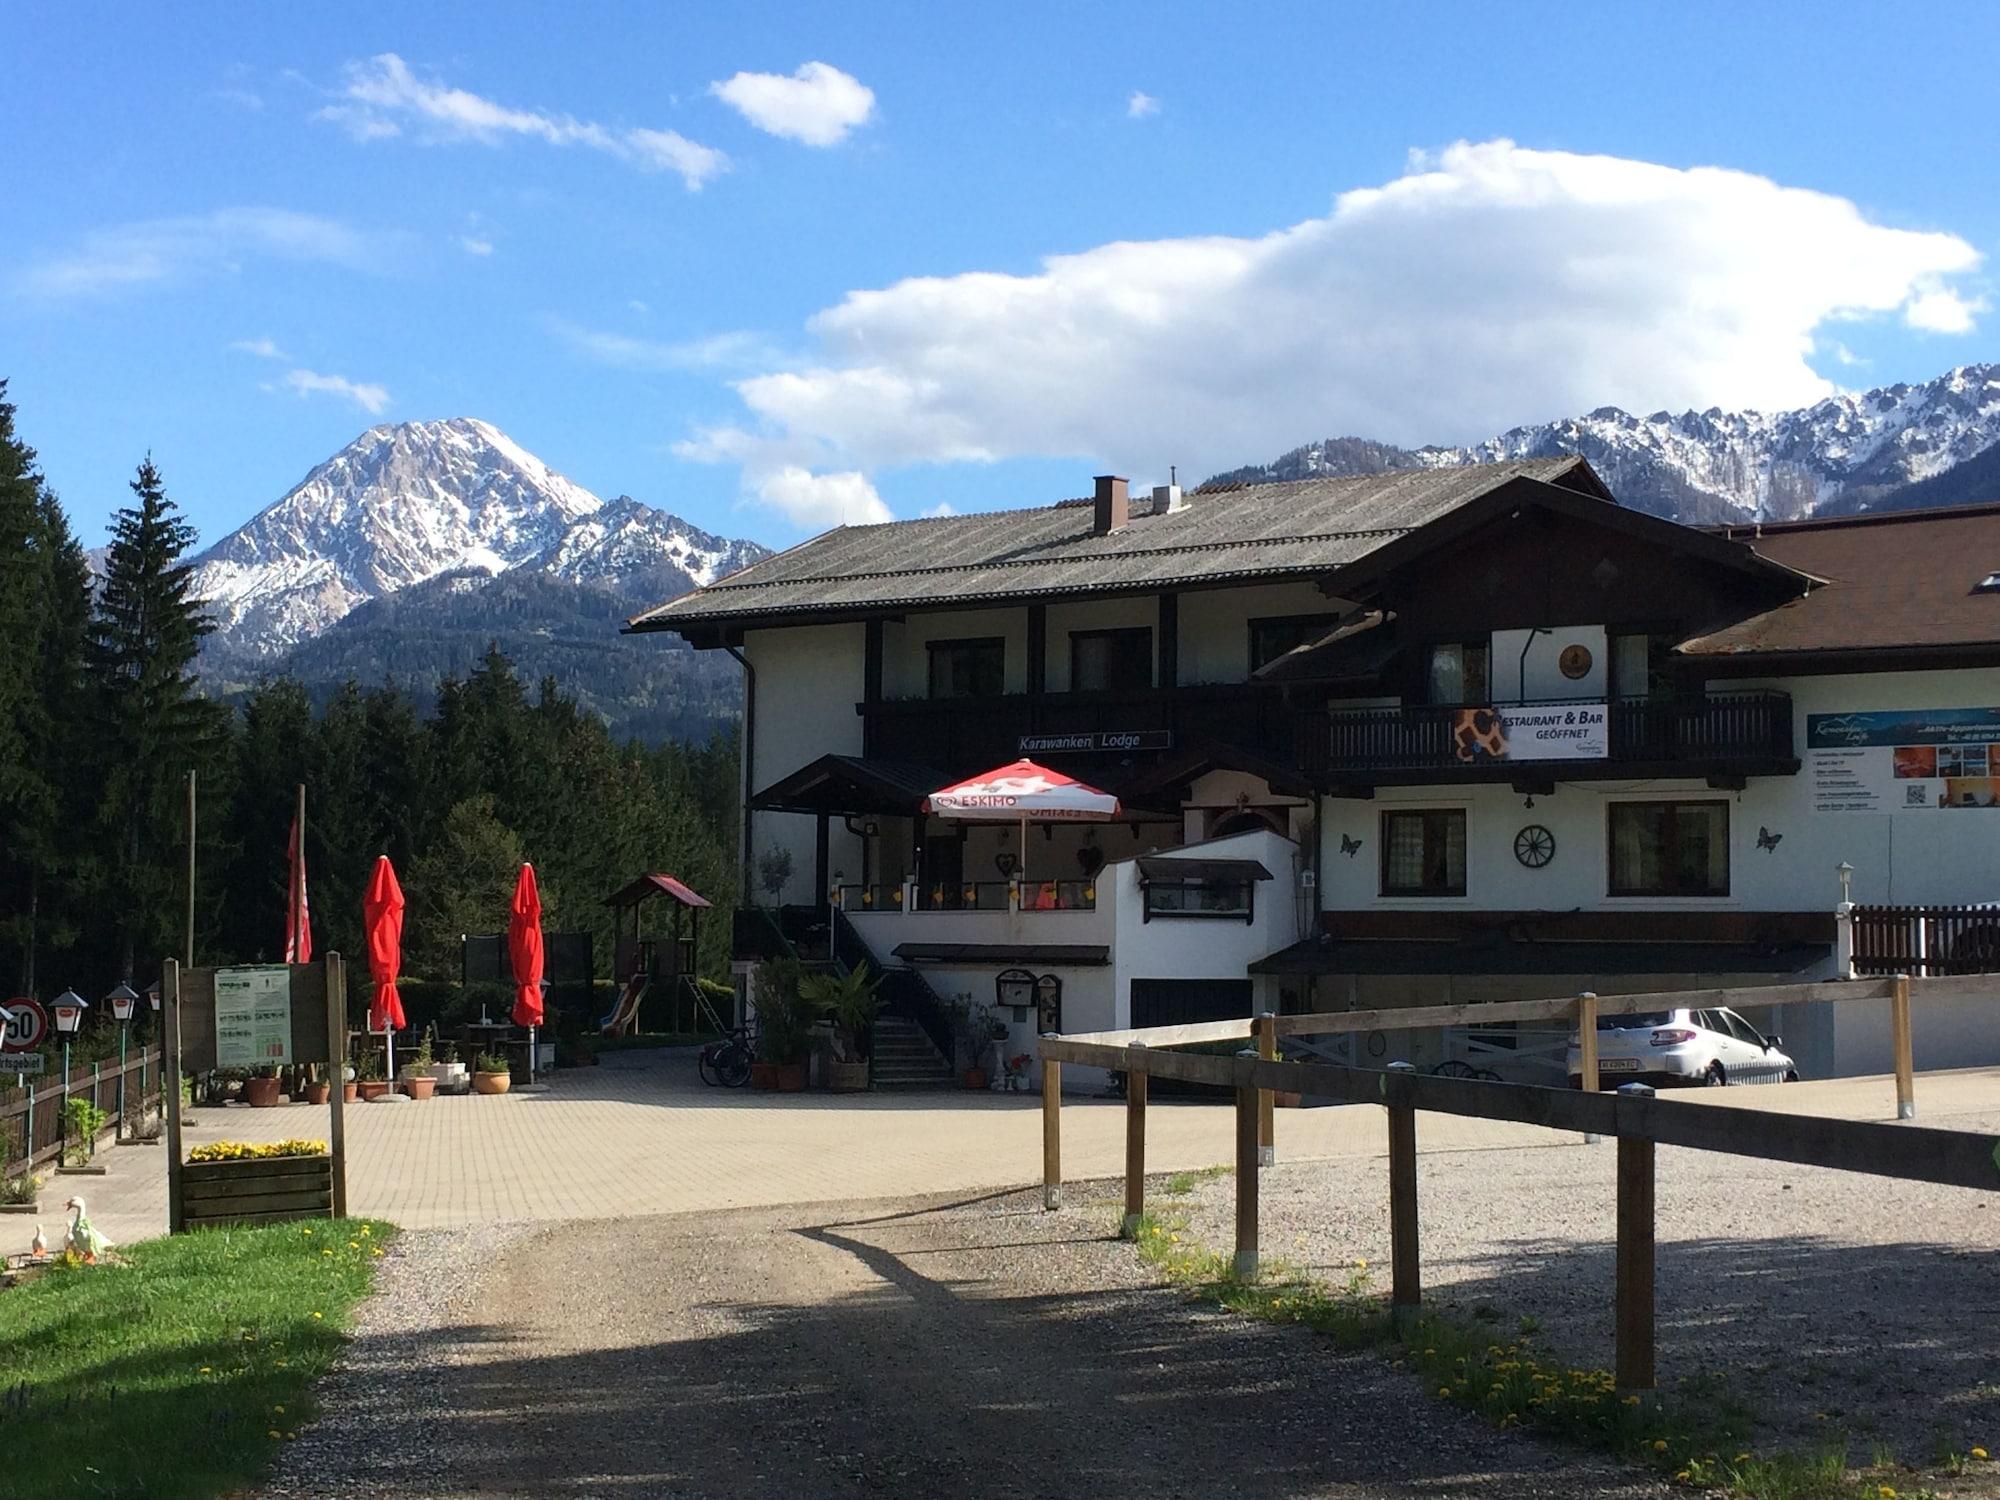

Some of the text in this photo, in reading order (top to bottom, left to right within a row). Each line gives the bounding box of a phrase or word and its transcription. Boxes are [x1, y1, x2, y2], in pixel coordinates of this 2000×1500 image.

[1564, 711, 1576, 725] &
[1579, 711, 1603, 724] BAR
[1536, 728, 1589, 740] GEÖFFNET
[1020, 734, 1140, 750] Karawanken Lodge
[961, 795, 1017, 807] ESKIMO
[7, 1012, 33, 1039] 50
[0, 1057, 40, 1071] rtsgebiet
